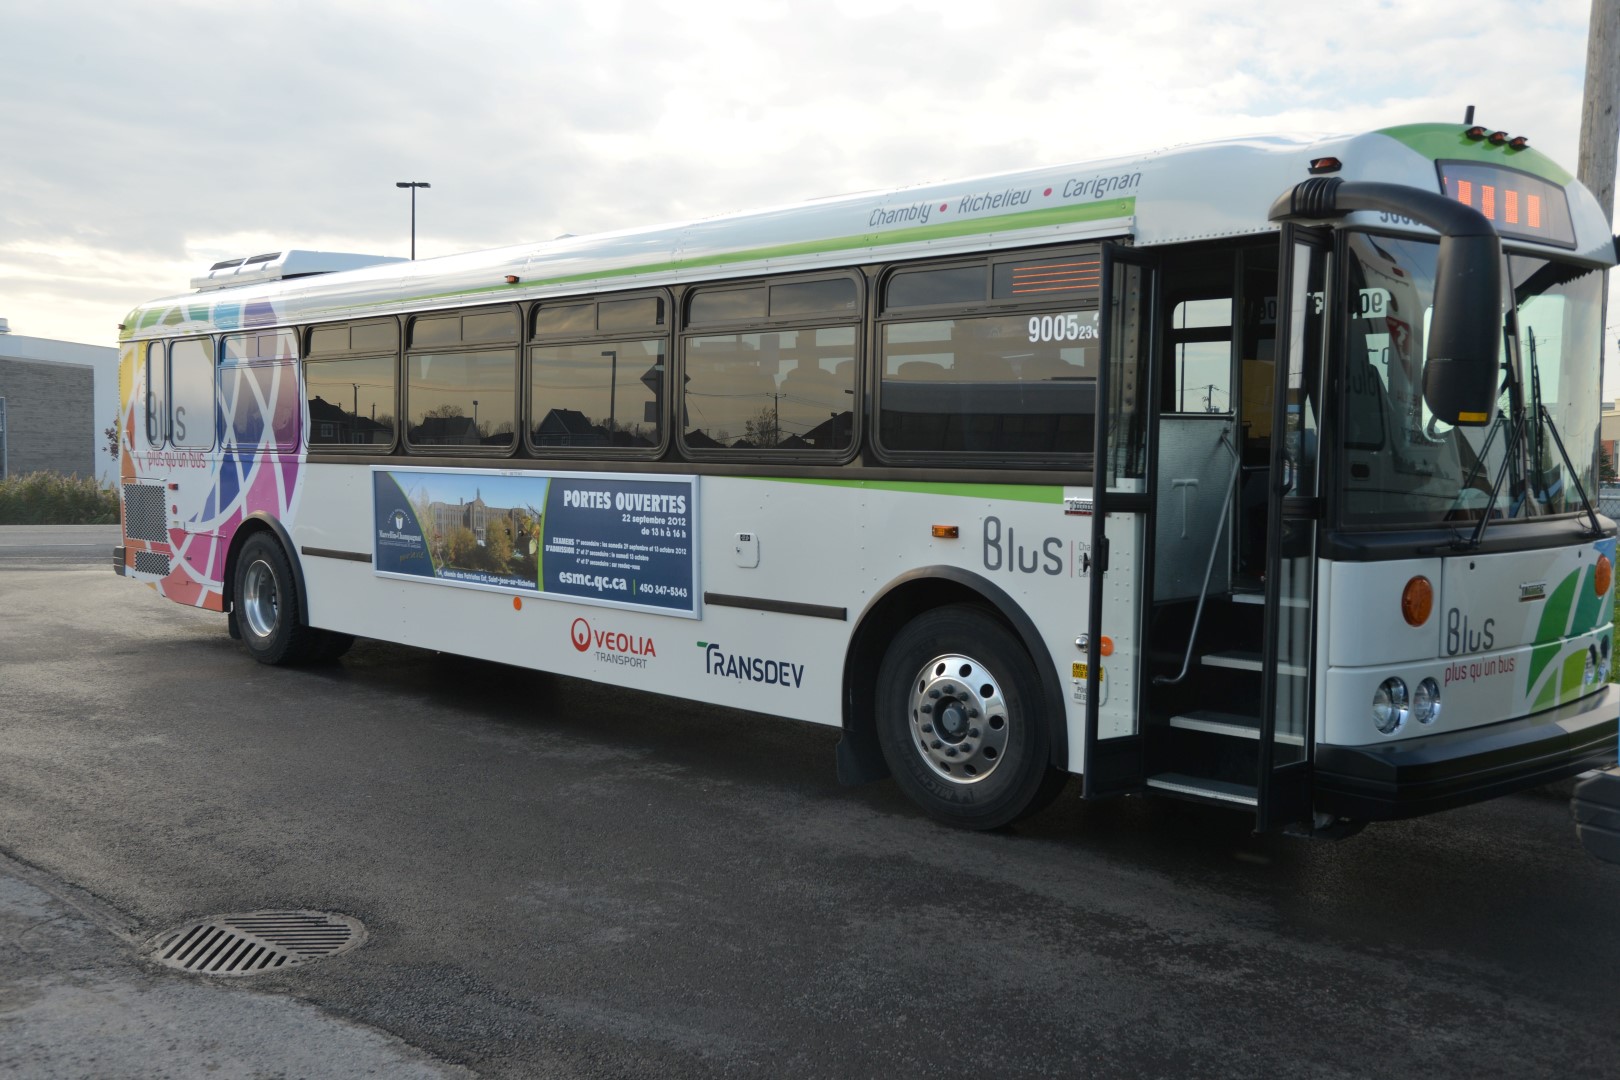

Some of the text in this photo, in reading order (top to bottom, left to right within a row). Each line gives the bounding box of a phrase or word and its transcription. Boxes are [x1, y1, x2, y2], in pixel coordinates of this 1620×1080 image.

[869, 172, 1141, 226] Chambly Richelieu Carignan
[189, 448, 206, 468] bus
[564, 490, 686, 514] PORTES OUVERTES
[622, 514, 686, 526] 22 septembre 2012
[552, 537, 574, 545] EXAMENS
[641, 527, 686, 538] de 13 h à 16 h
[546, 545, 574, 554] D'ADMISSION
[984, 516, 1063, 575] BluS
[559, 572, 627, 591] esmc.qc.ca
[640, 584, 688, 598] 450 347-5343
[1446, 608, 1495, 656] BluS
[594, 629, 656, 657] VEOLIA
[595, 651, 648, 669] TRANSPORT
[696, 641, 804, 688] TRANSDEV
[1444, 661, 1467, 688] plus
[1499, 655, 1514, 674] bus
